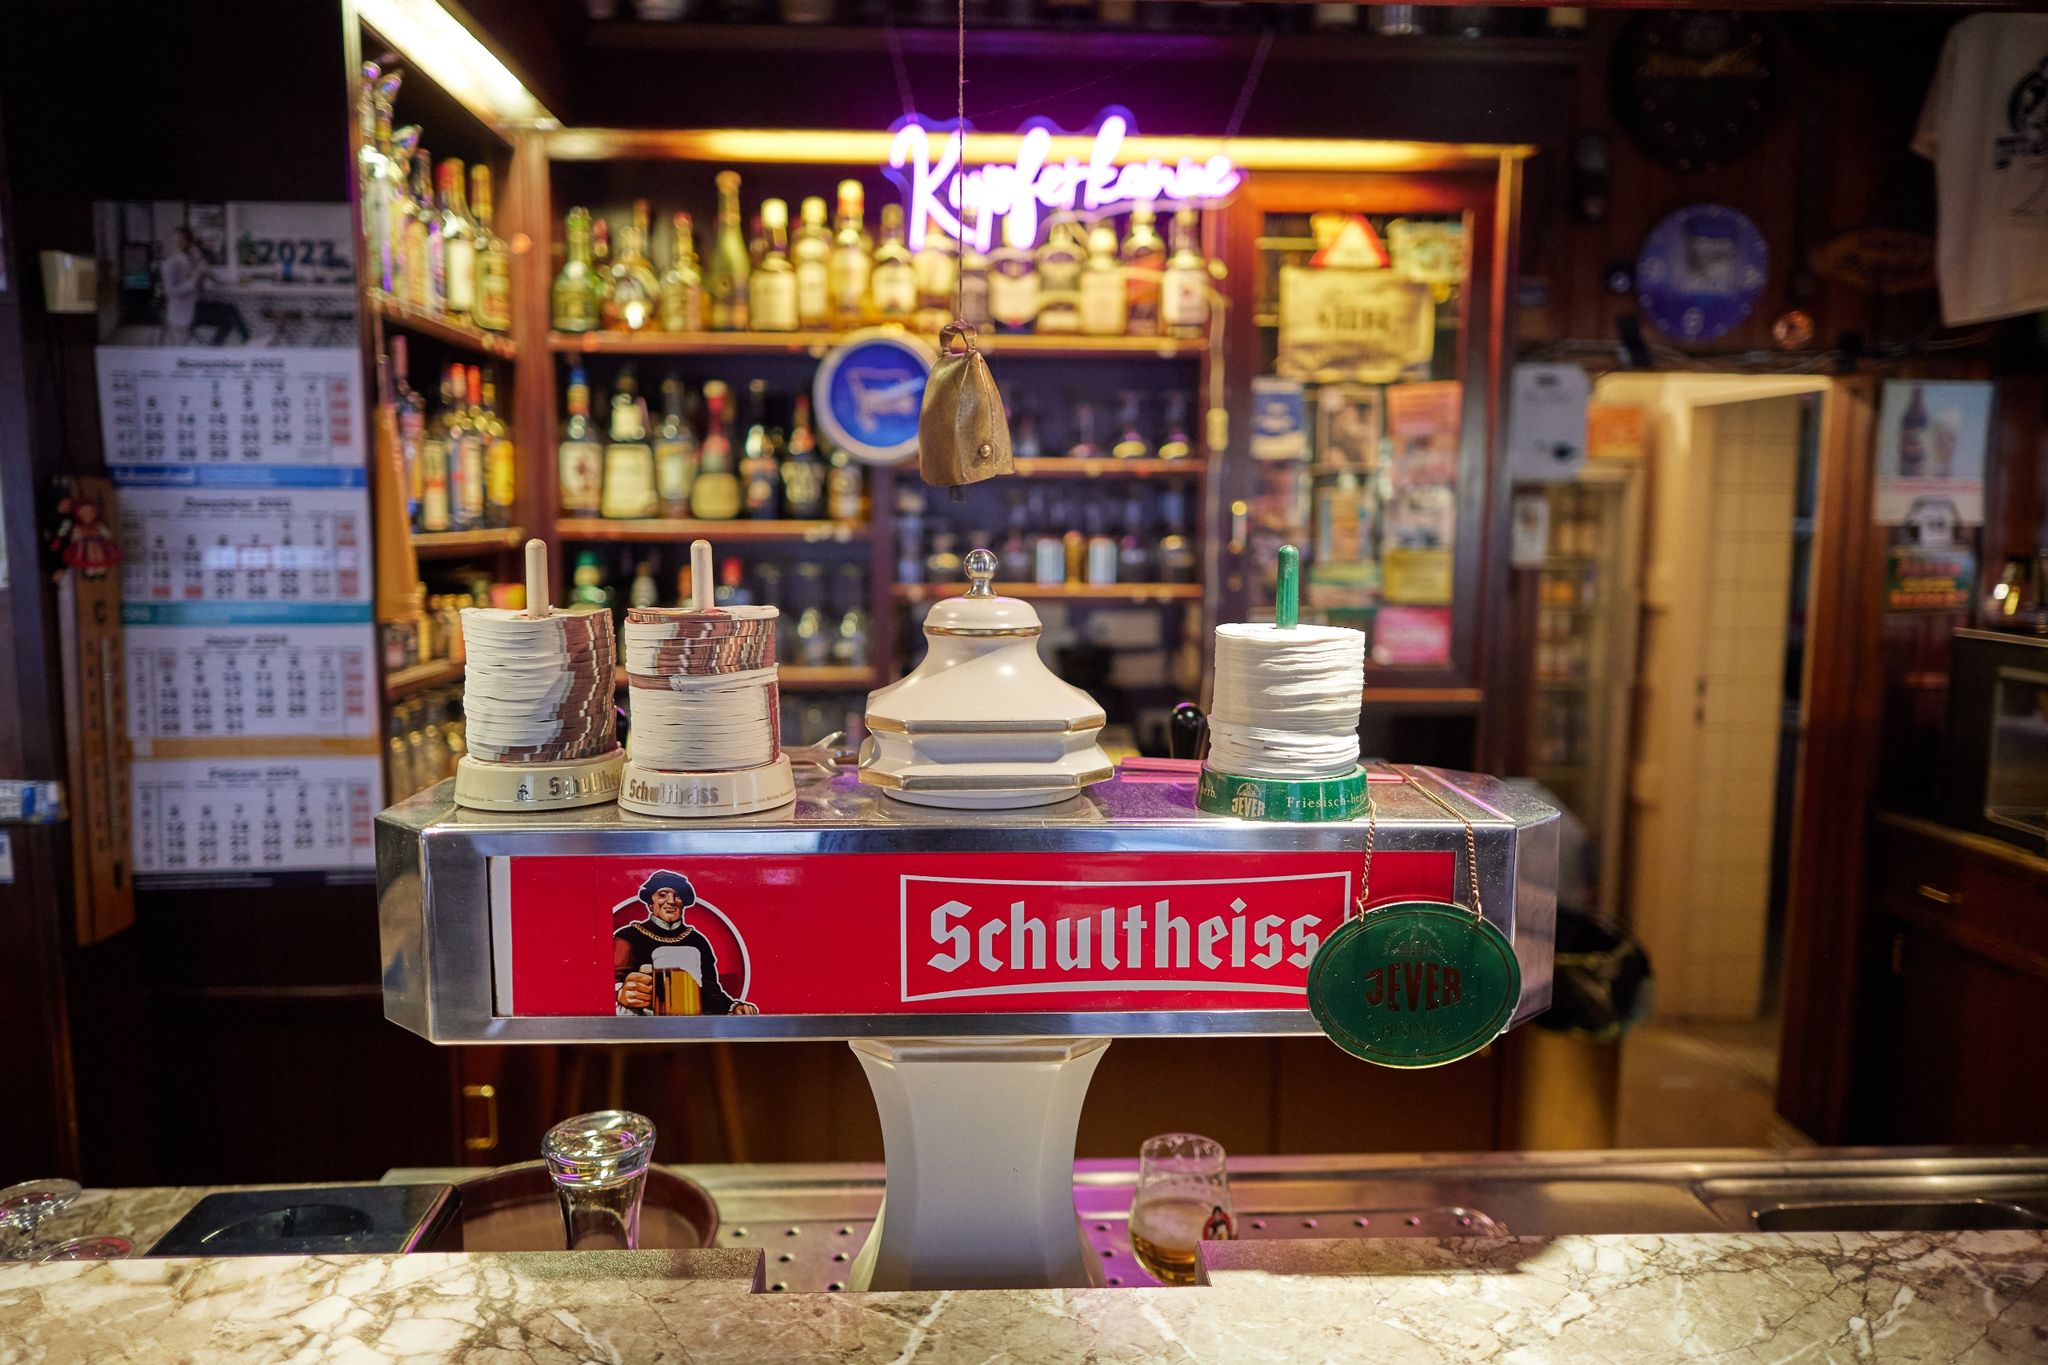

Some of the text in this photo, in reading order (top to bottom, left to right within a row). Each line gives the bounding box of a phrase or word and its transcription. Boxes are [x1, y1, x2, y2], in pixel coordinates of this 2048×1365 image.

[629, 779, 719, 804] Schultheiss
[1231, 796, 1266, 818] JEVER
[927, 897, 1322, 973] Schultheiss
[1365, 960, 1462, 1013] JEVER
